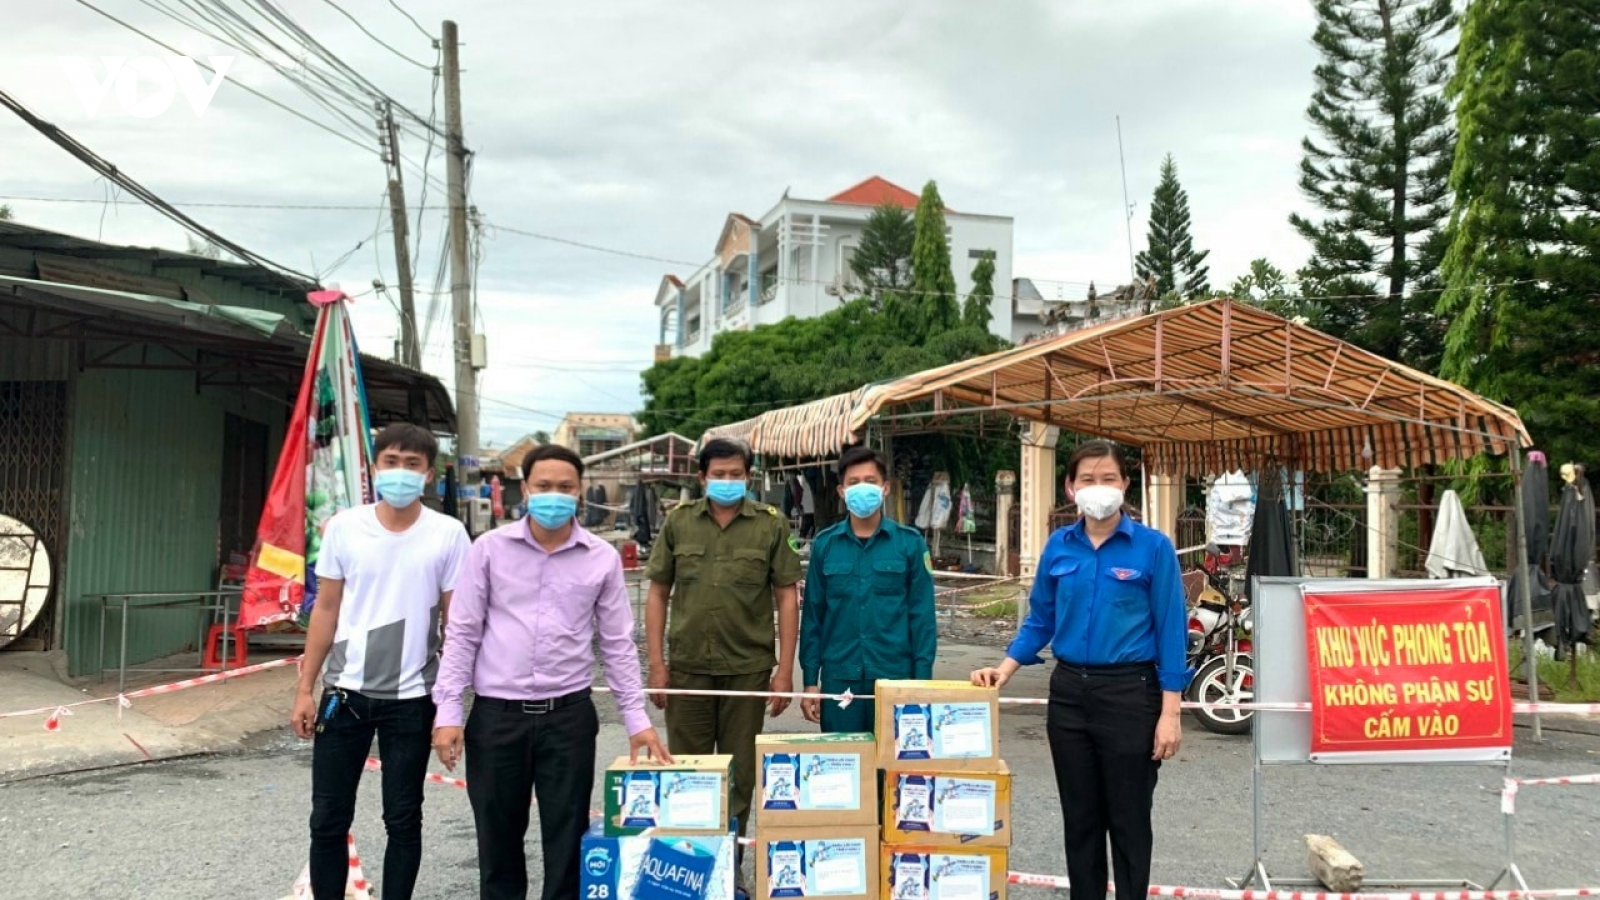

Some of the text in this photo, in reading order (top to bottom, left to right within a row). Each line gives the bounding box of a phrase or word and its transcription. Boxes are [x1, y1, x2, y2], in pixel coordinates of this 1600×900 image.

[1316, 605, 1492, 676] KHU VỰC PHONG TỎA
[1324, 675, 1495, 707] KHÔNG PHẬN SỰ
[1364, 708, 1459, 738] CẤM VÀO
[640, 854, 706, 896] AQUAFINA
[587, 884, 610, 899] 28
